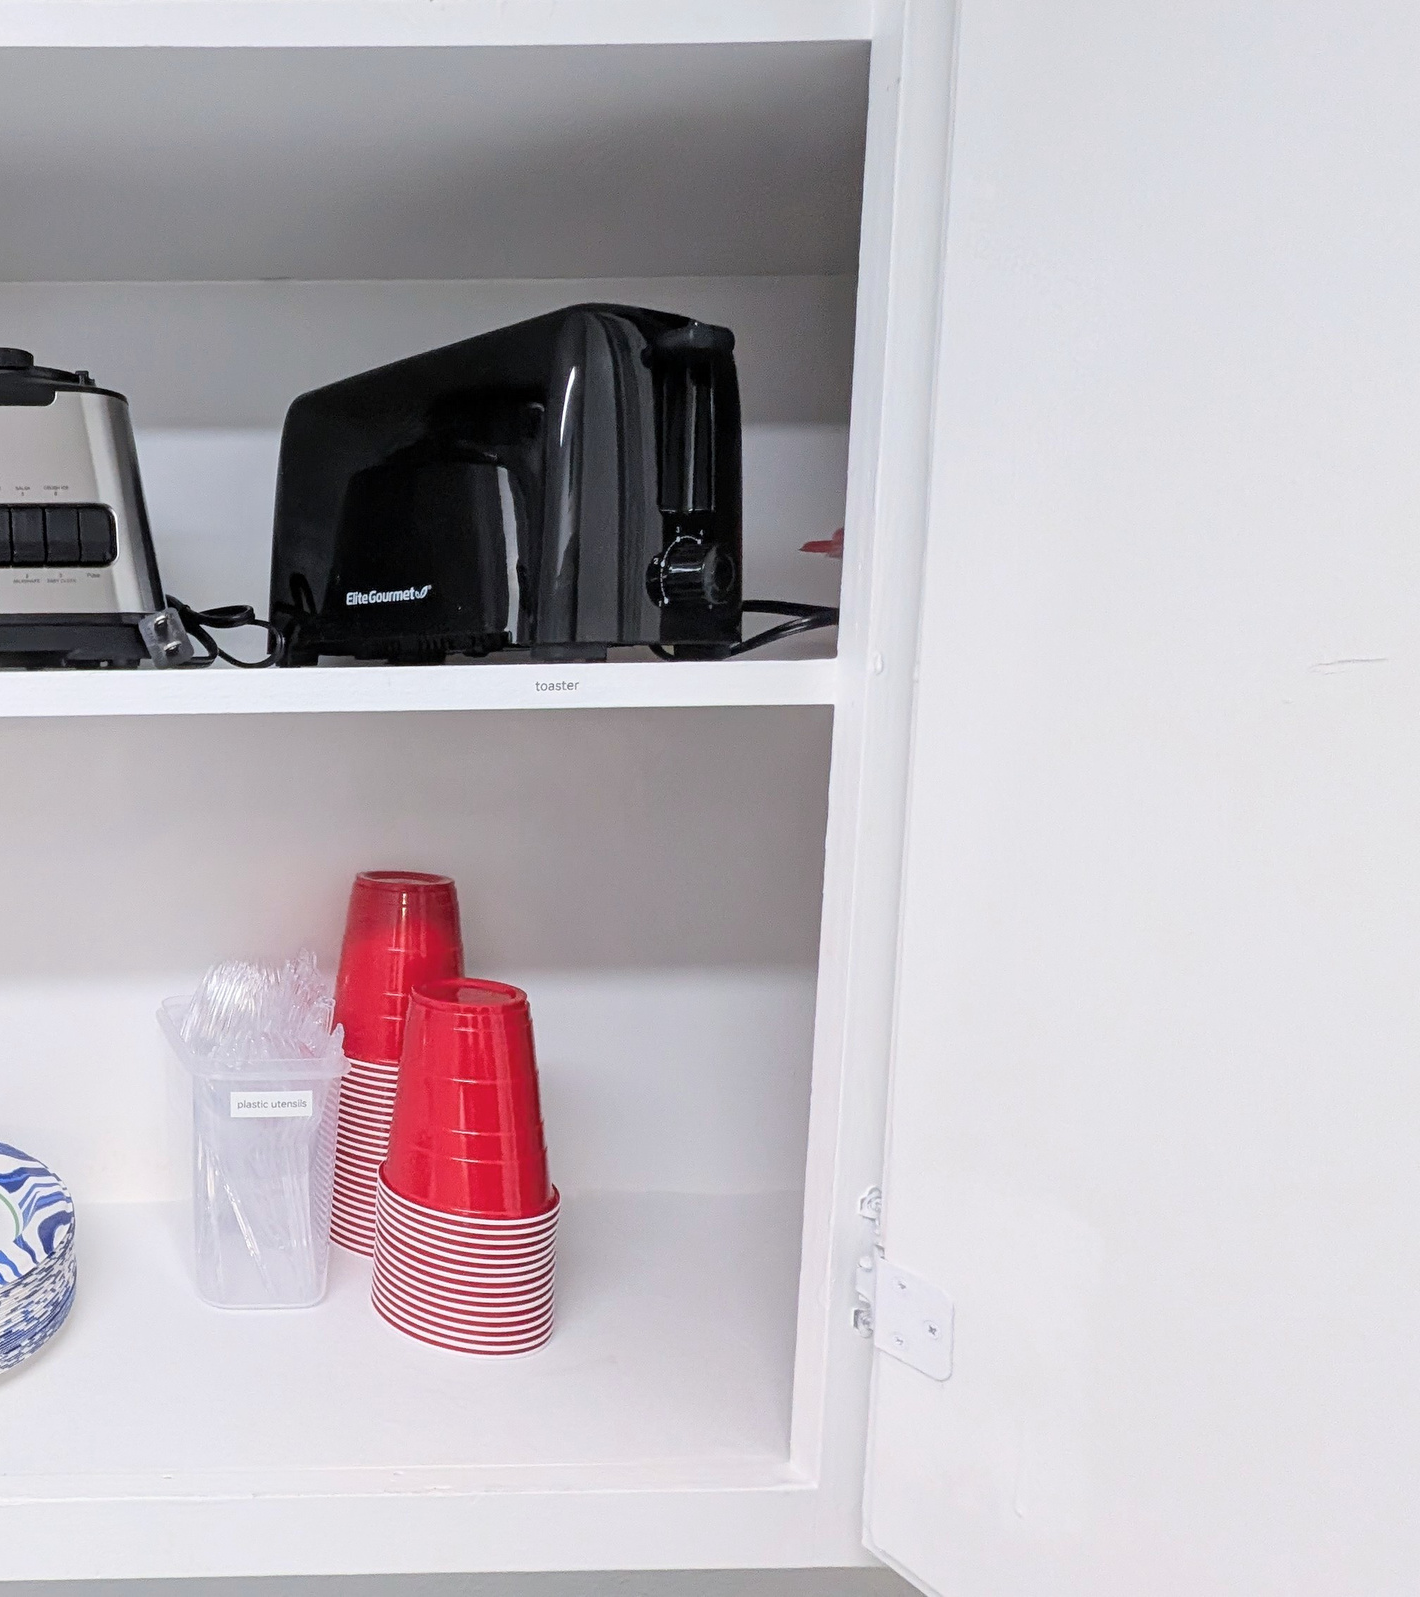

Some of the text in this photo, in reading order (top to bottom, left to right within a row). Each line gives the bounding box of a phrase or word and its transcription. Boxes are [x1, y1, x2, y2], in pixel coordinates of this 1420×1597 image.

[653, 557, 659, 565] 2
[535, 680, 580, 692] toaster
[237, 1098, 308, 1110] plastic utensils
